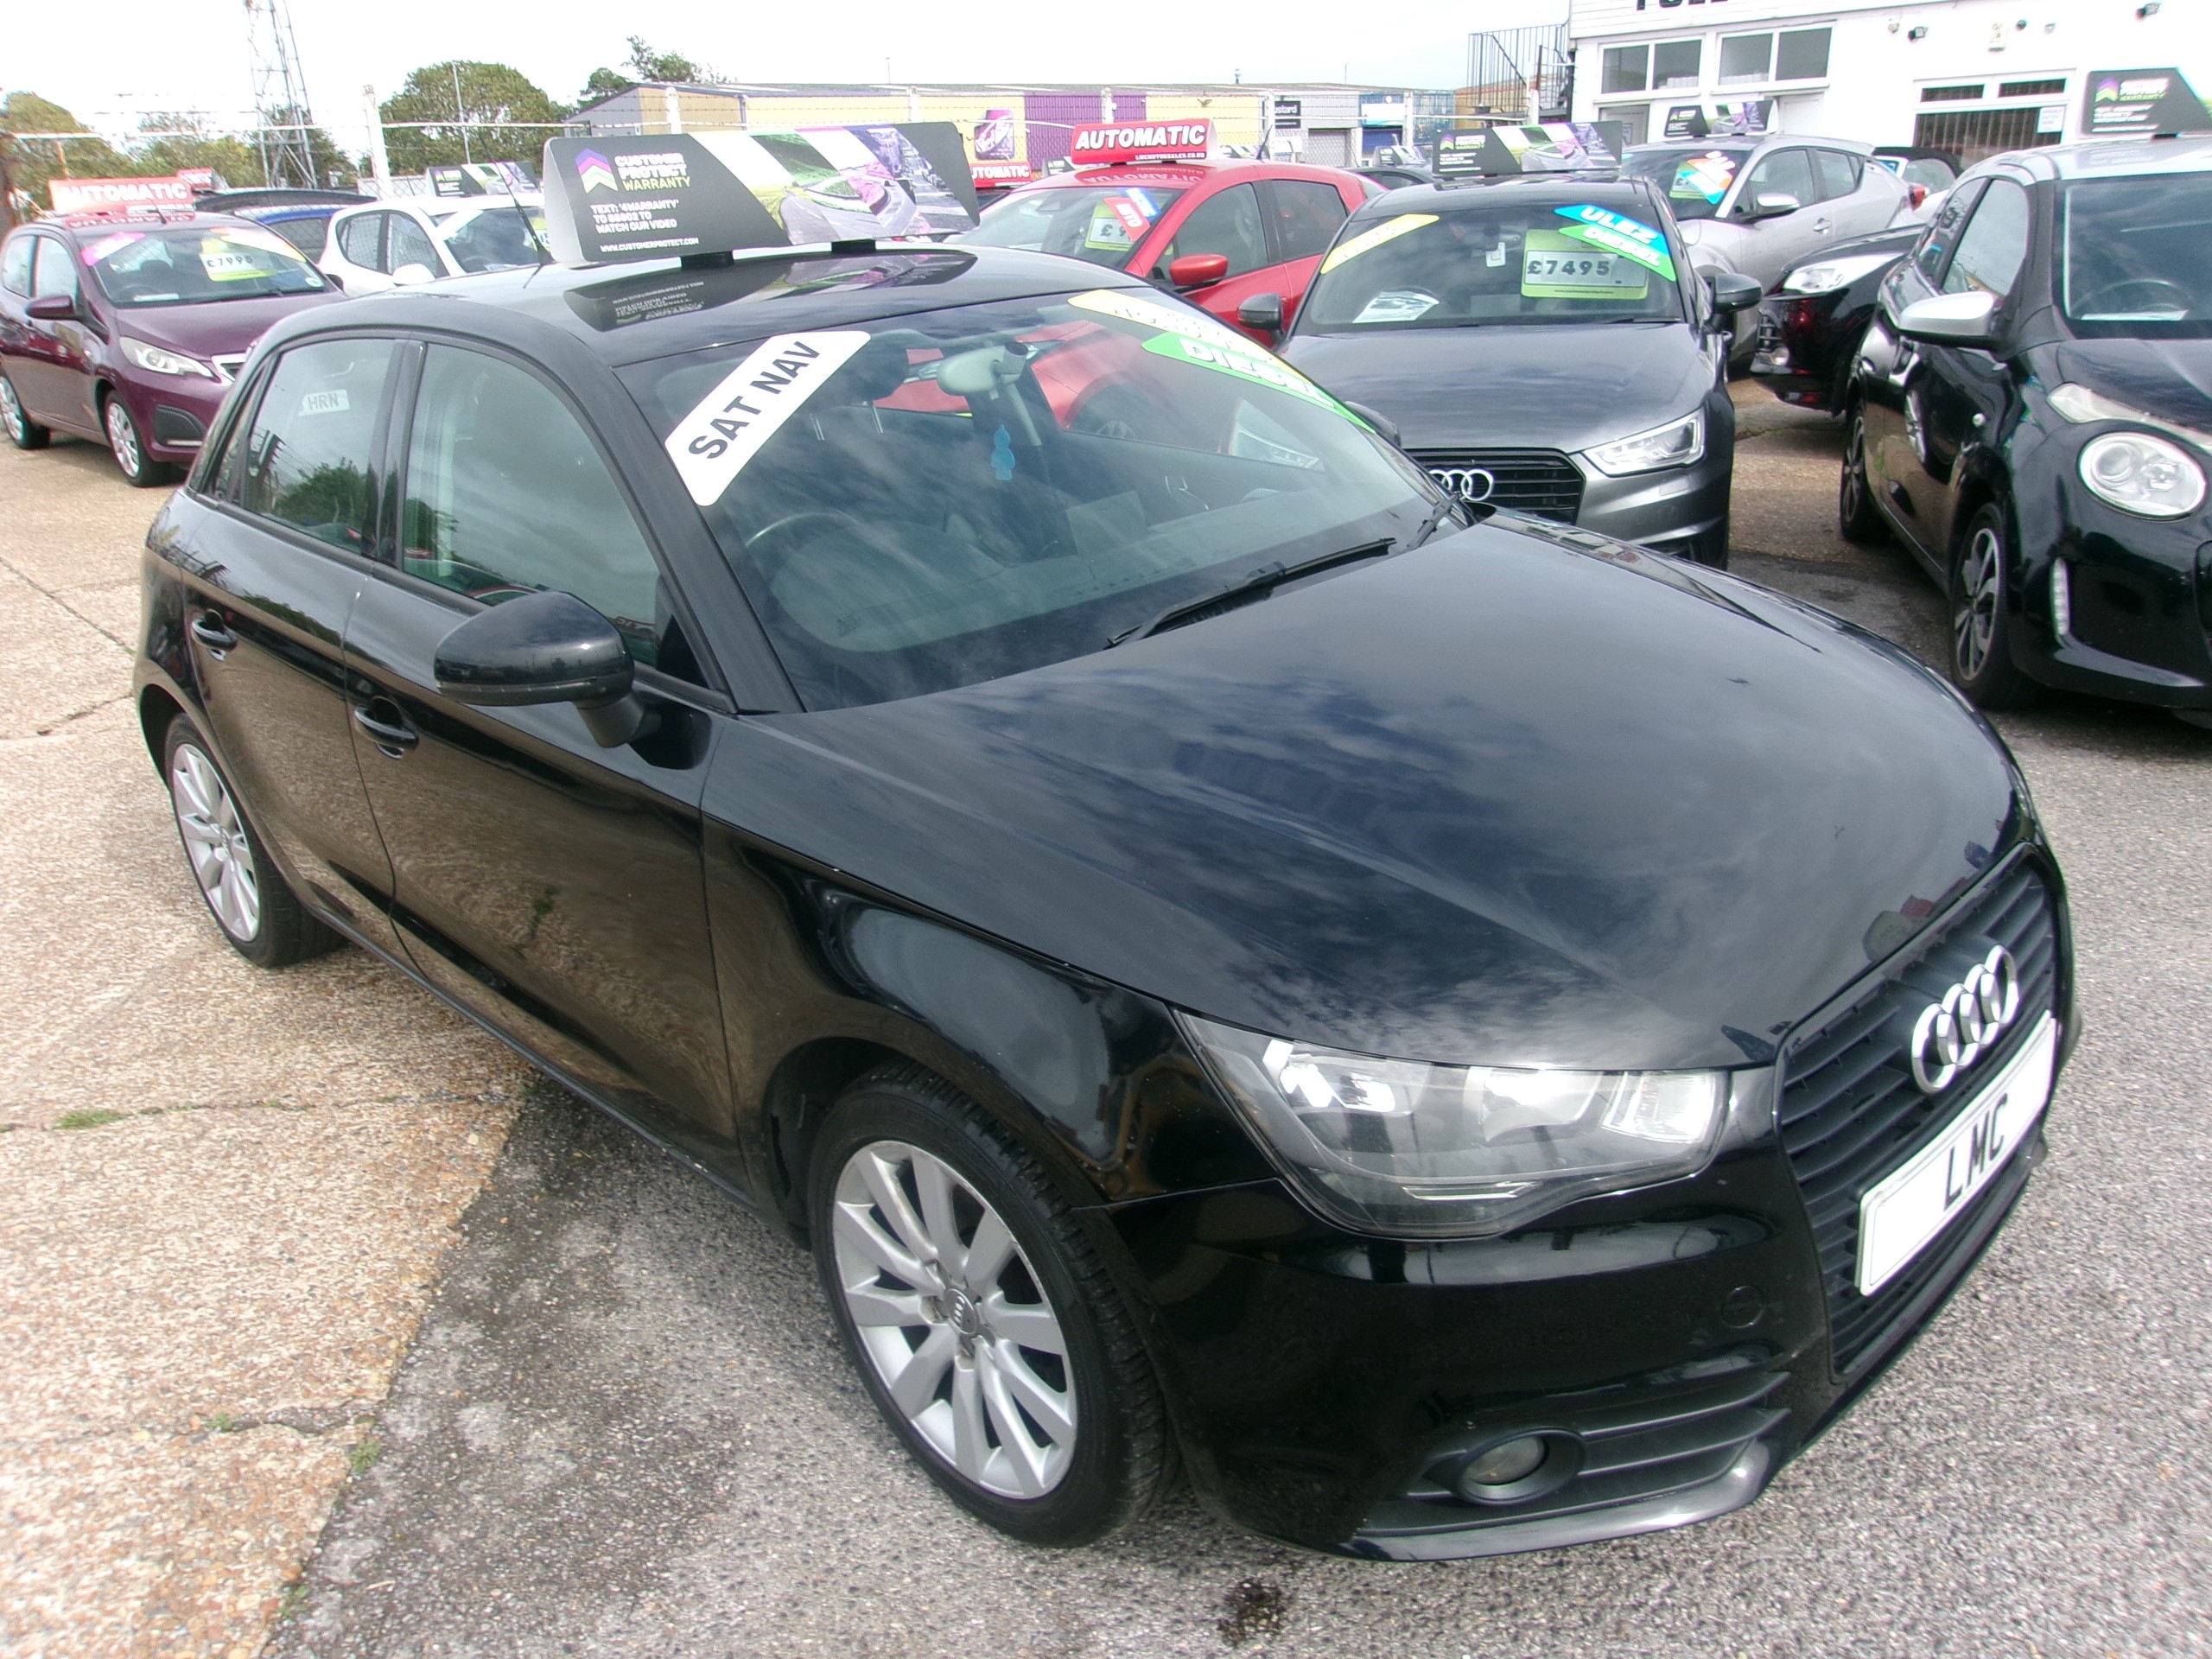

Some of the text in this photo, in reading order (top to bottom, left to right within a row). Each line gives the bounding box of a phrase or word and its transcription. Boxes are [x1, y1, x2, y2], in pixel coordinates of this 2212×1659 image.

[1274, 105, 1297, 114] ustard
[1074, 124, 1205, 150] AUTOMATIC
[614, 153, 684, 167] CUSTOMER
[618, 163, 687, 180] PROTECT
[971, 165, 1030, 180] UTOMATIC
[622, 176, 690, 191] WARRANTY
[57, 182, 188, 203] AUTOMATIC
[590, 204, 619, 214] TEXT:
[593, 214, 607, 224] TO
[639, 211, 652, 220] TO
[595, 219, 677, 234] WATCH OUR VIDEO
[1580, 207, 1658, 245] ULEZ
[1582, 226, 1660, 267] DIESEL
[1527, 260, 1610, 276] £7495
[1178, 337, 1335, 408] DIESEL
[307, 392, 340, 411] HRN
[688, 340, 821, 459] SAT NAV
[1943, 1092, 2008, 1211] LMC
